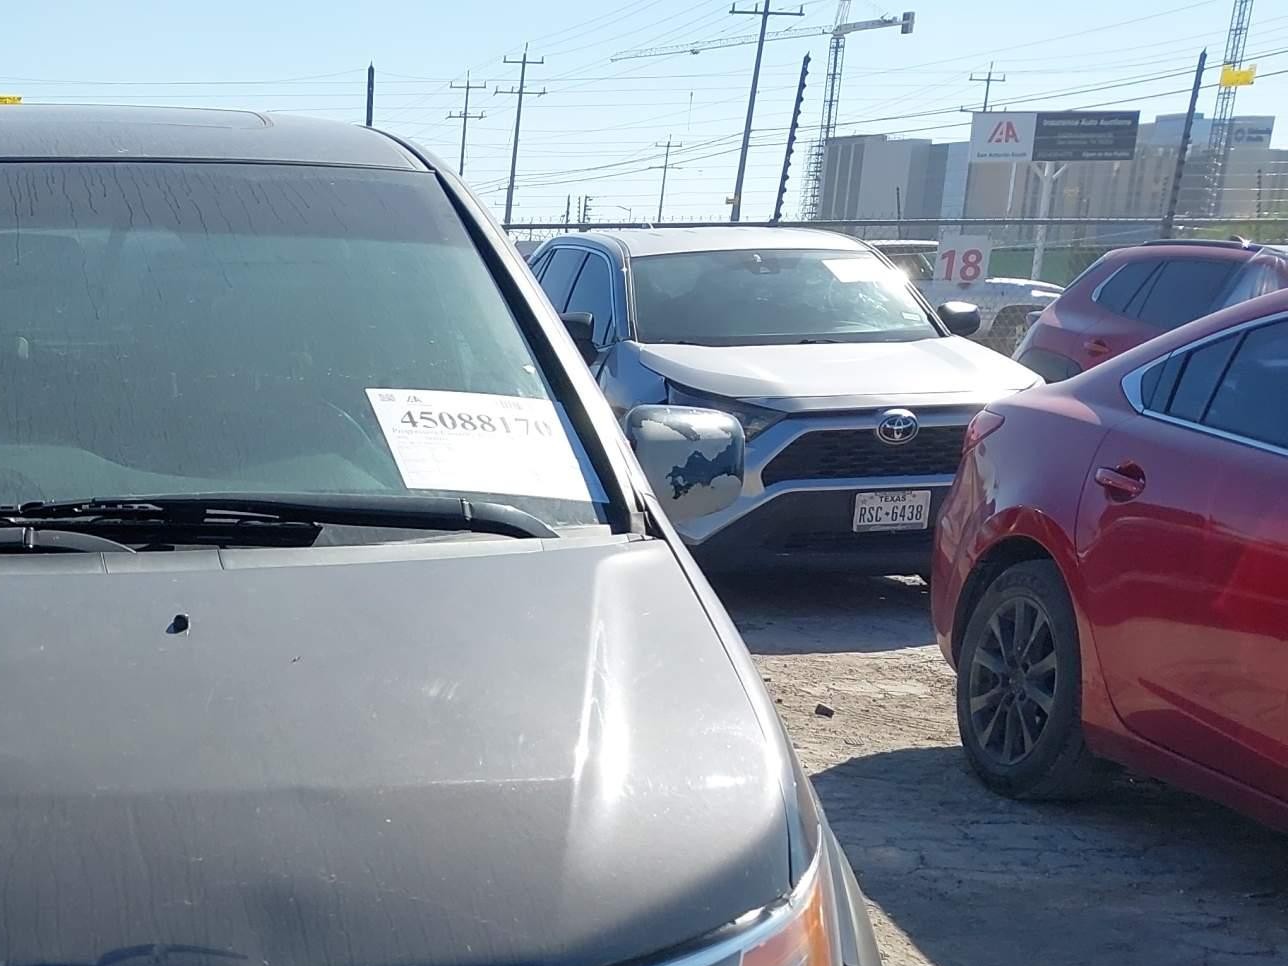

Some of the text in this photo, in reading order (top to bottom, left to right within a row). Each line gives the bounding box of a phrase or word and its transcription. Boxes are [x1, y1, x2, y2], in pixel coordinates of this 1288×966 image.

[941, 249, 983, 281] 18
[400, 410, 554, 438] 45088170
[880, 495, 907, 503] TEXAS
